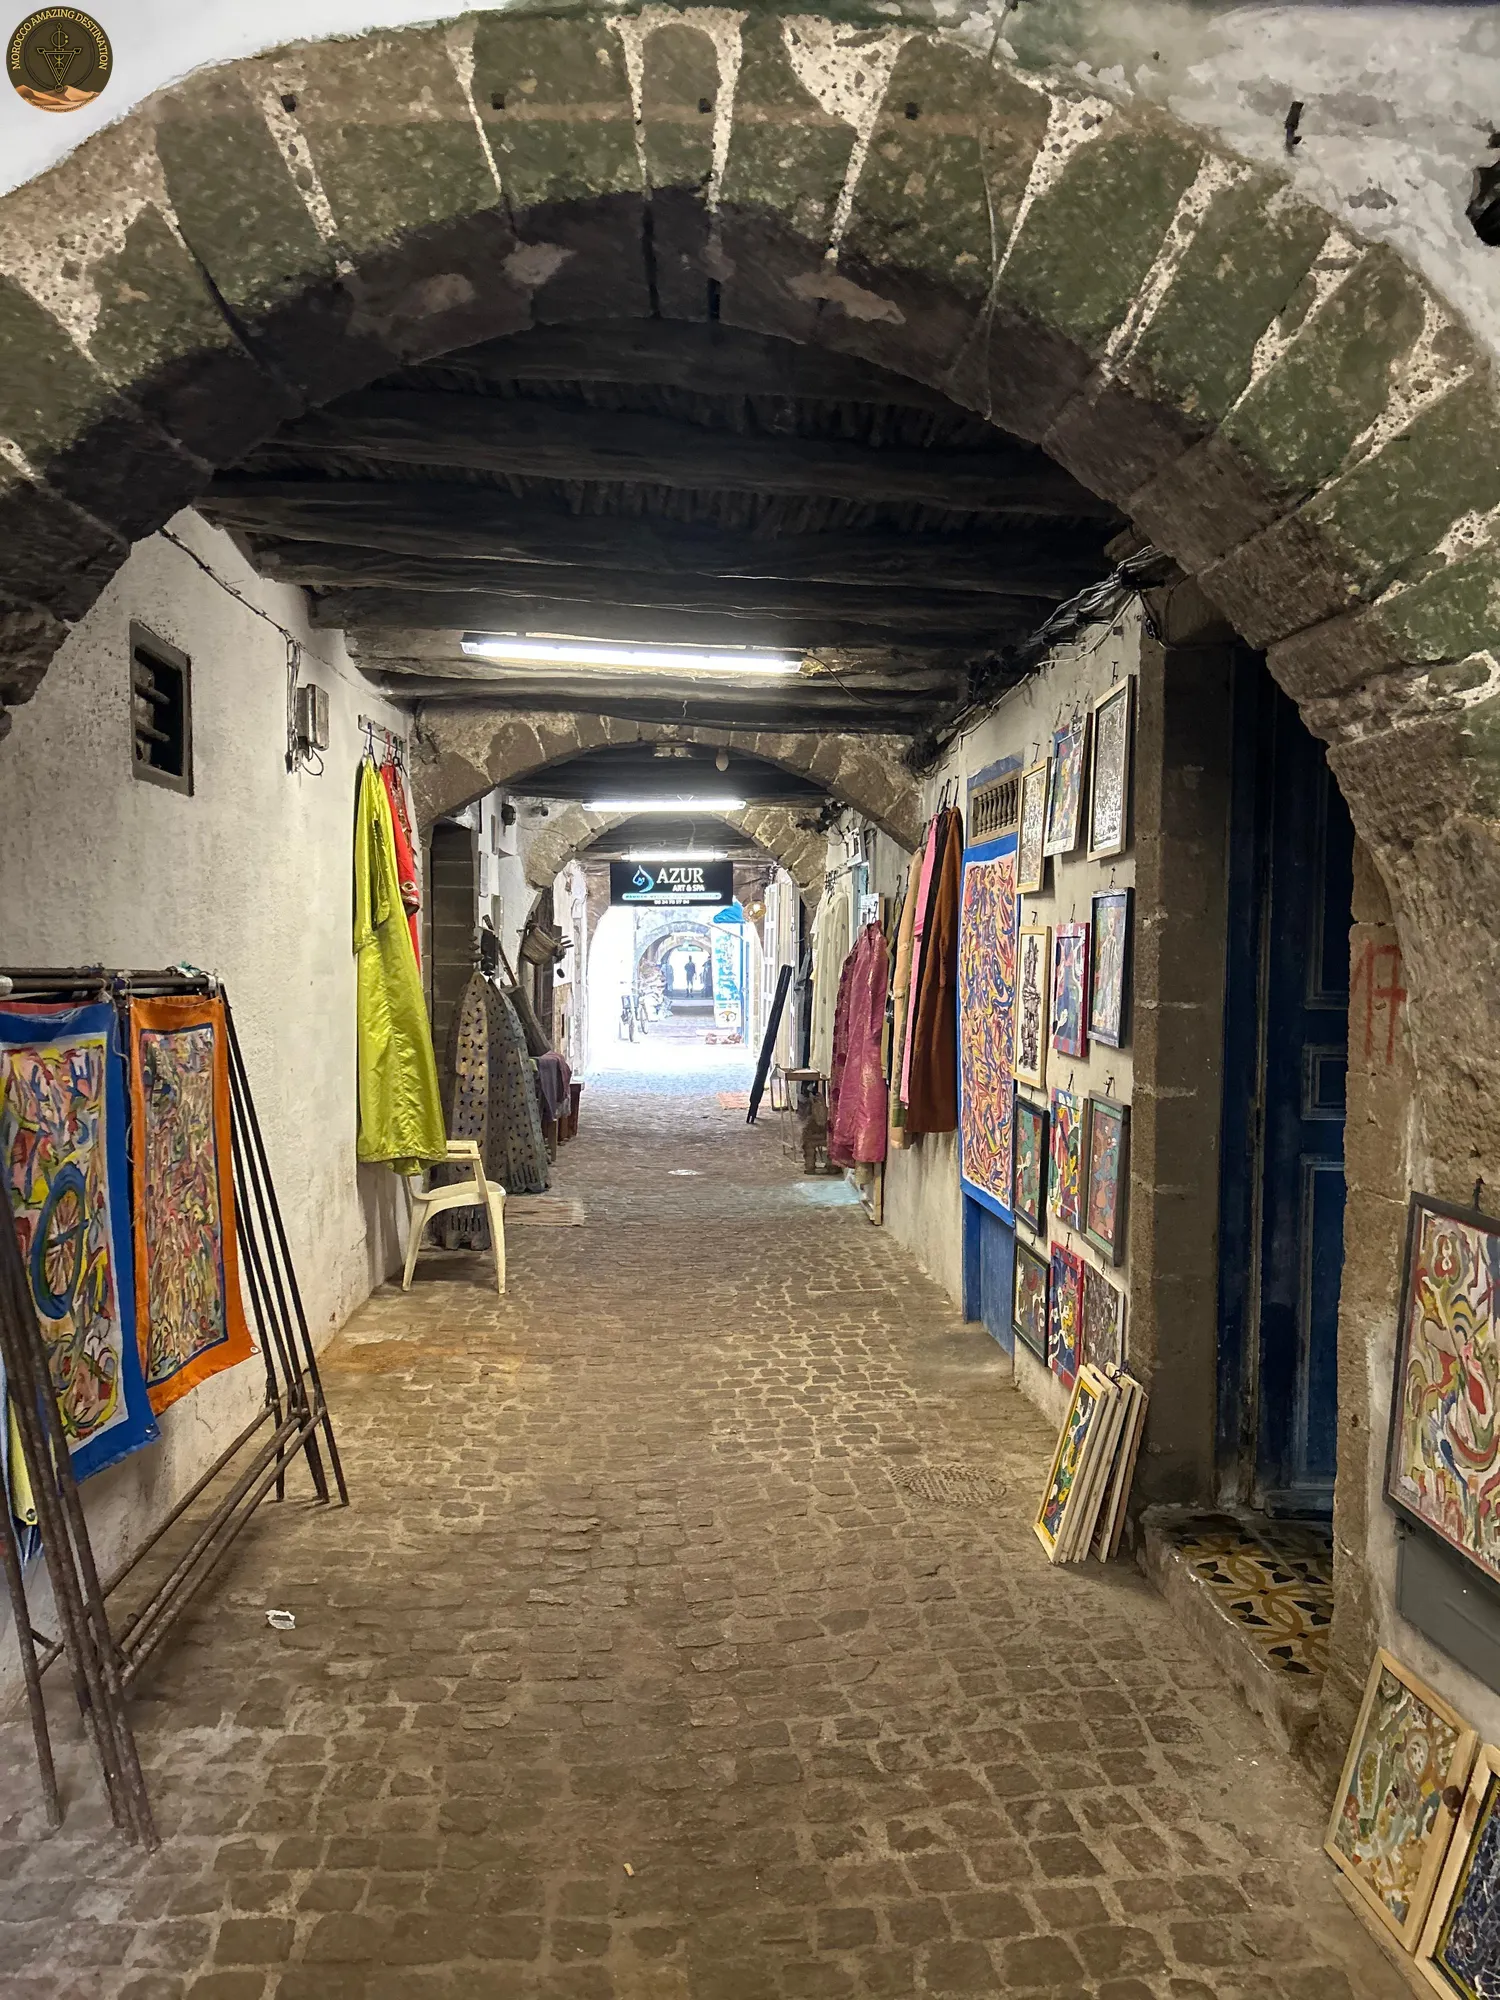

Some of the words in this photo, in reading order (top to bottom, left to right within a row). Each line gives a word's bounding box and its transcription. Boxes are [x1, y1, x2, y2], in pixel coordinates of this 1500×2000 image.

[656, 867, 704, 884] AZUR
[672, 884, 685, 892] ART
[692, 884, 705, 892] SPA
